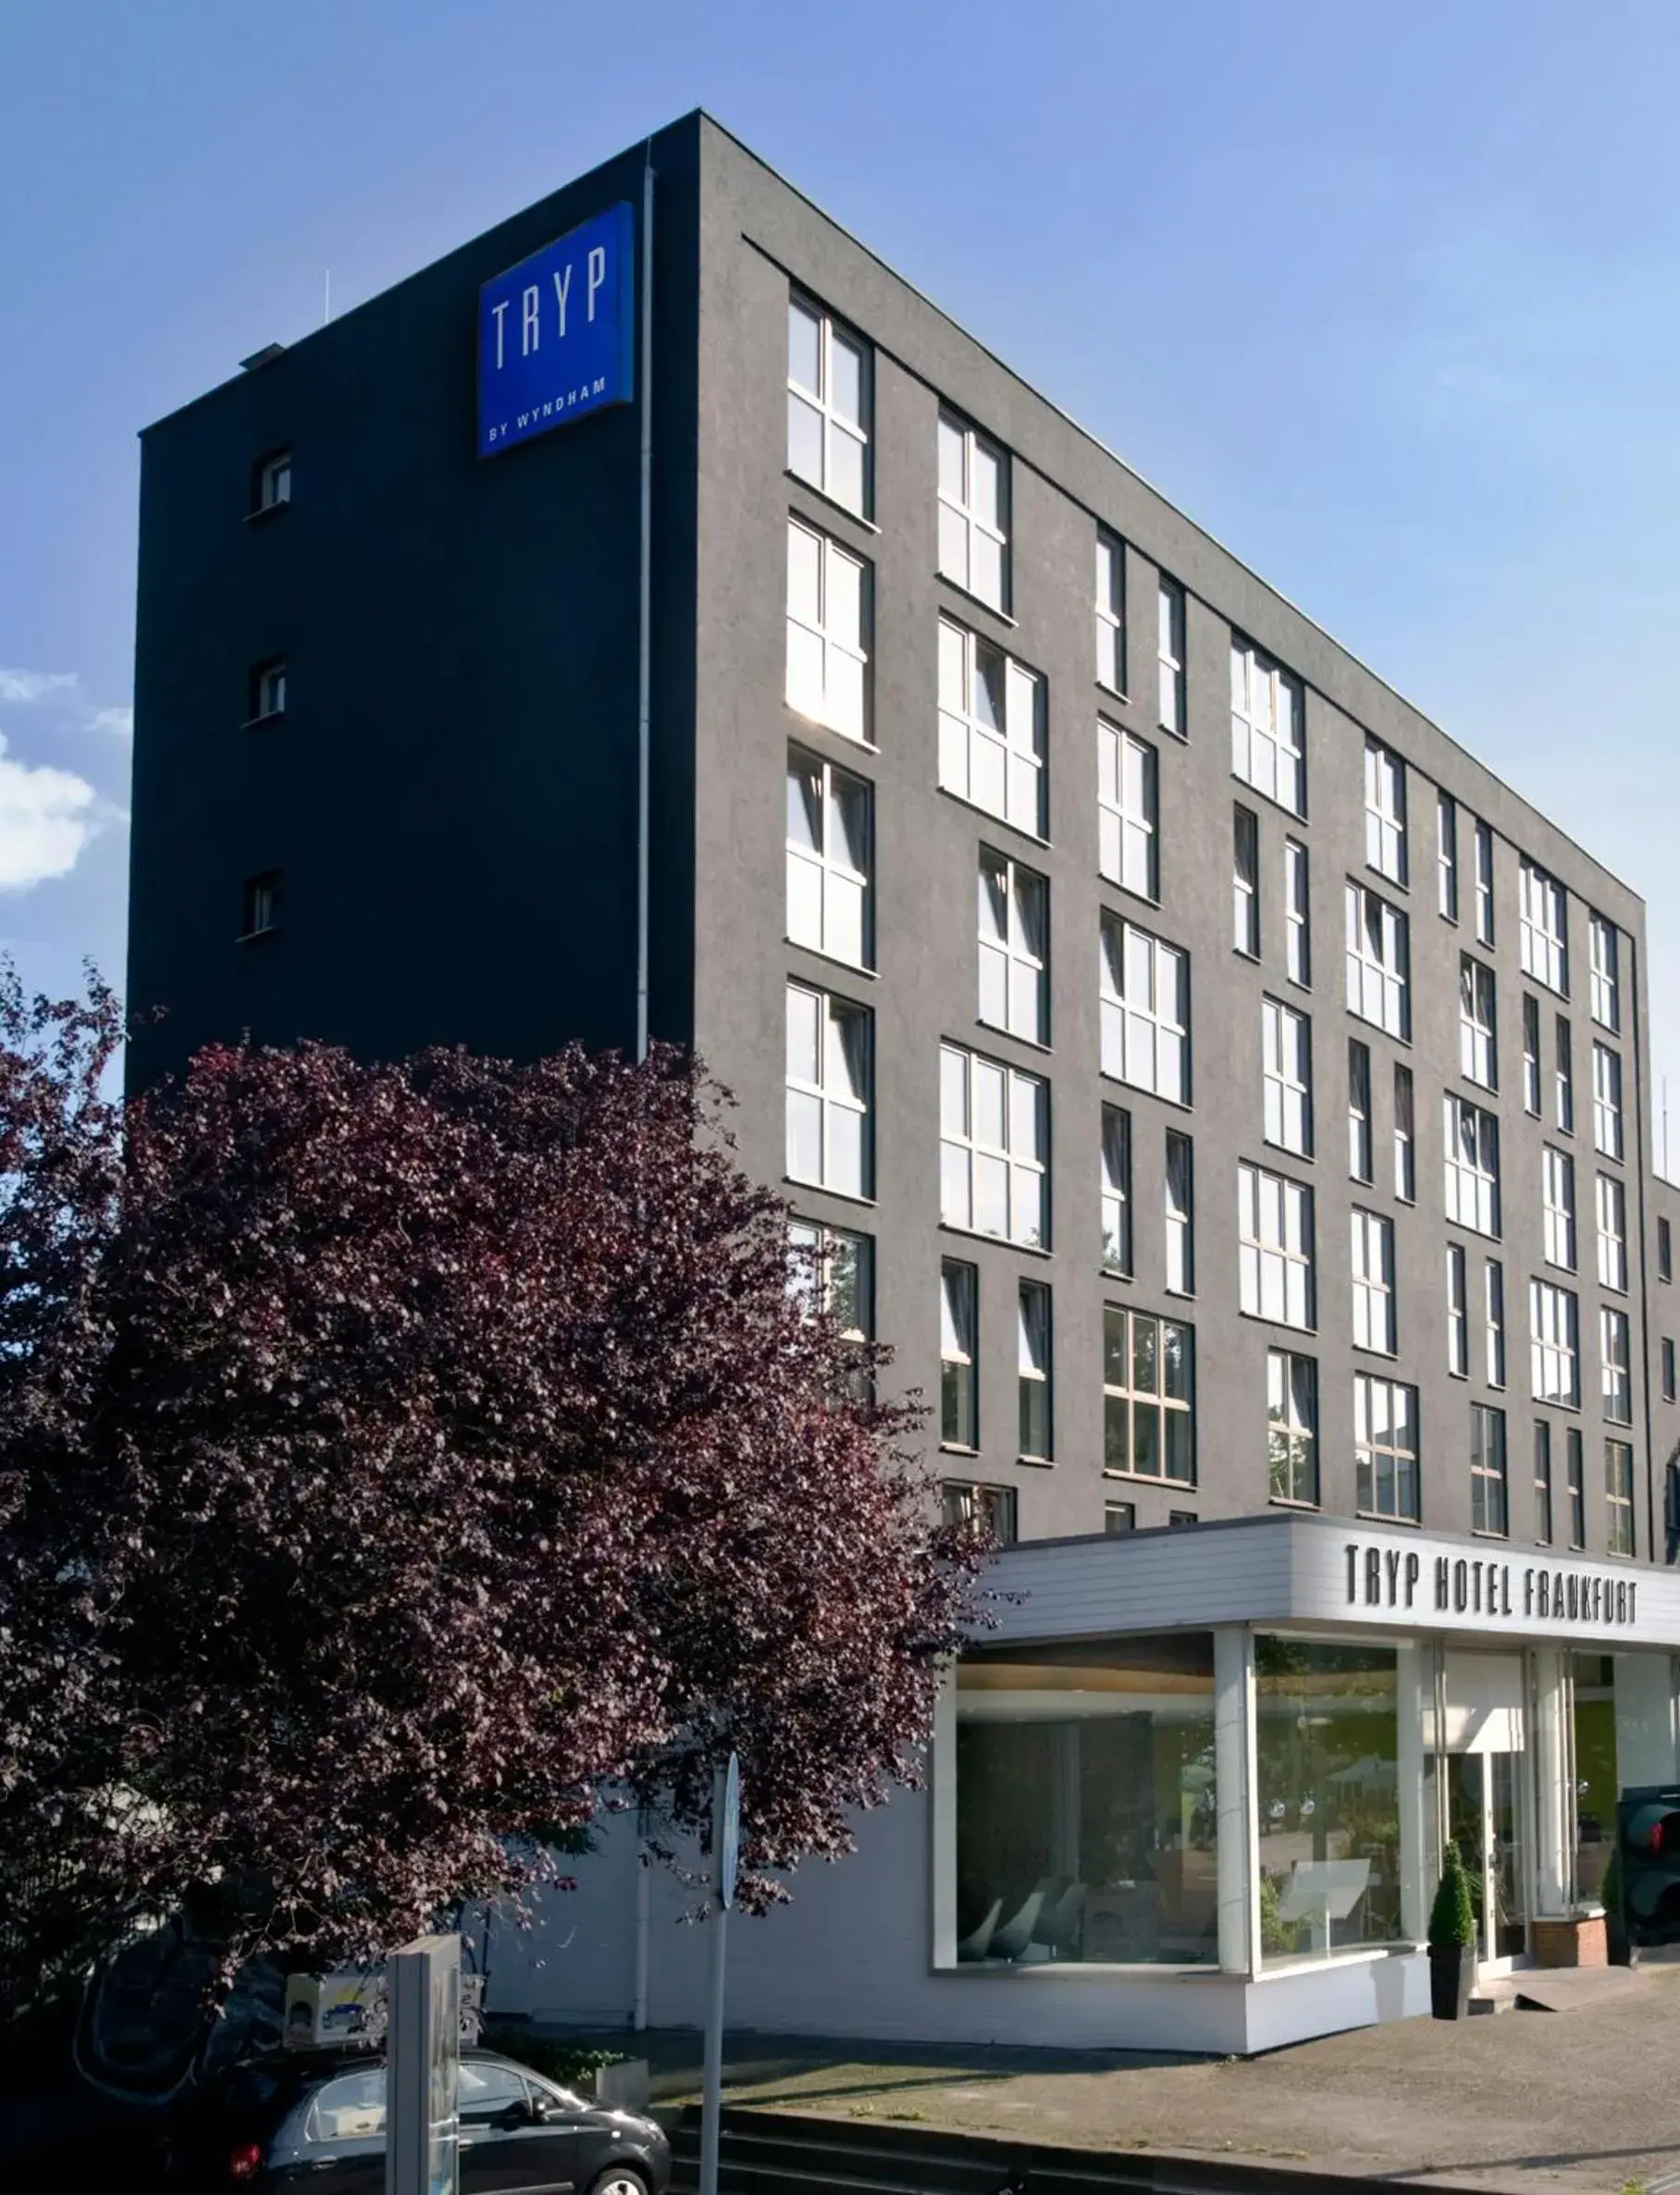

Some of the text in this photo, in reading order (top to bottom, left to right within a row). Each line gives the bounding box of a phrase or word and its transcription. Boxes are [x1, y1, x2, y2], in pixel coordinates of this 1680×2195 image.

[491, 246, 605, 369] TRYP
[488, 377, 605, 441] BY WYNDHAM
[1345, 1544, 1637, 1624] TRYP HOTEL FRANKFURT
